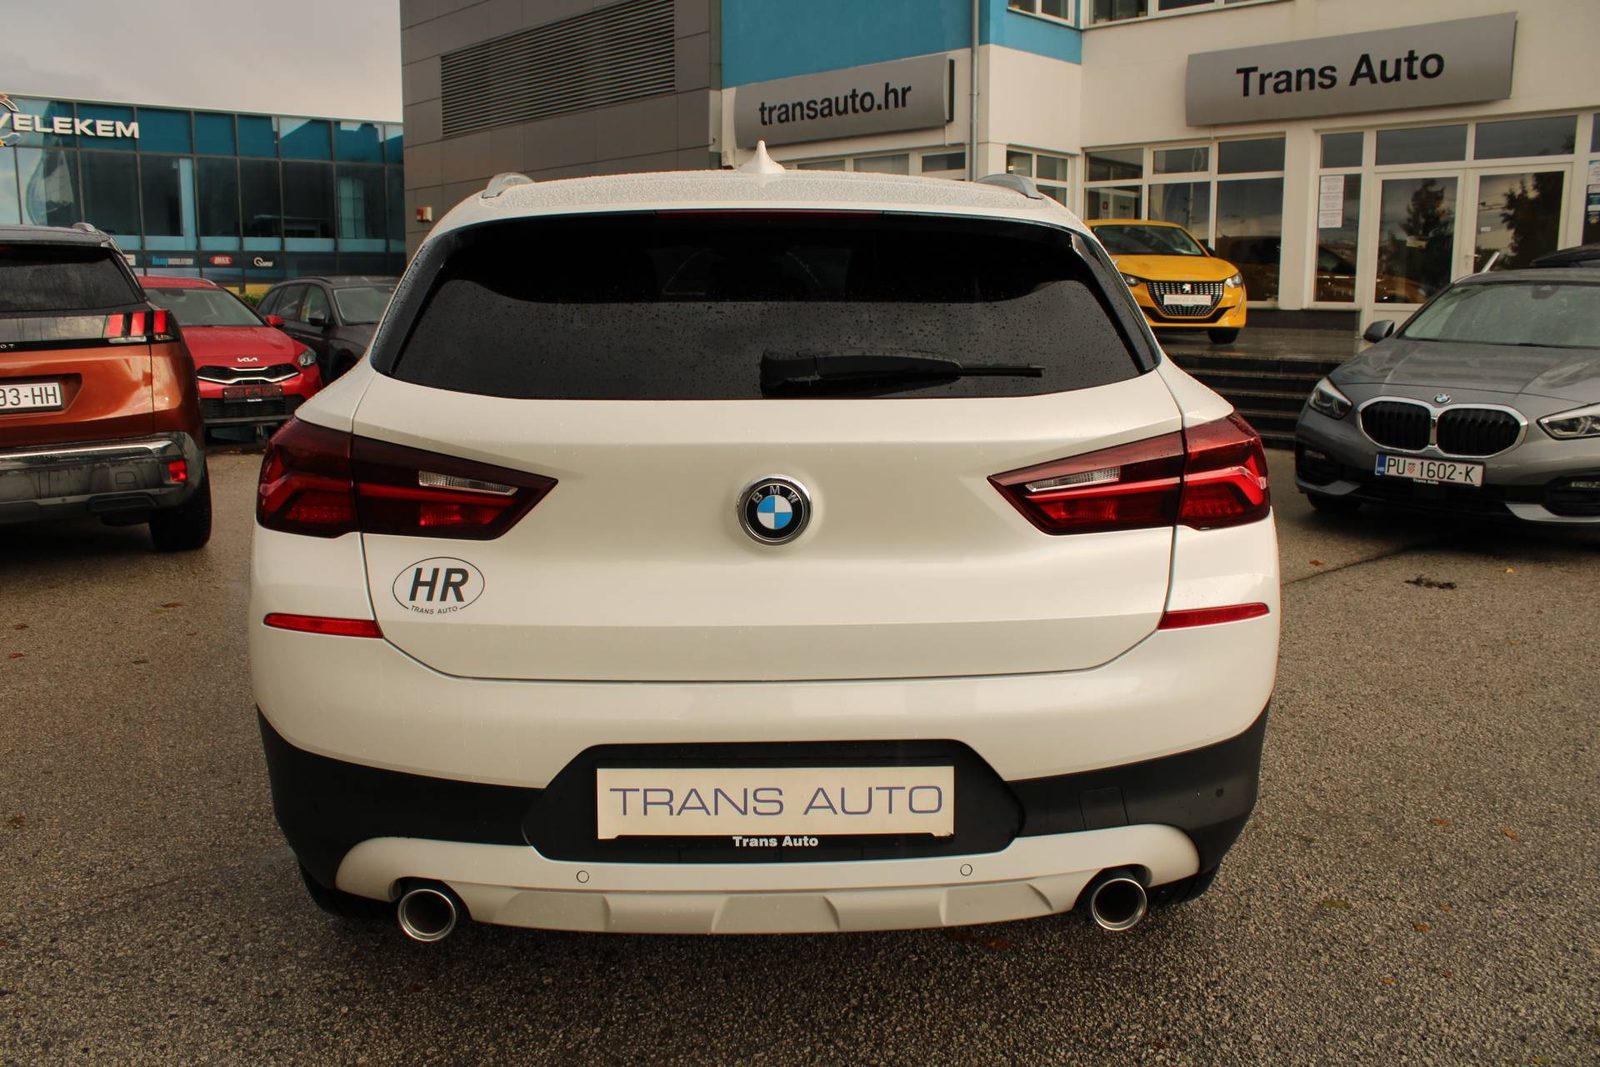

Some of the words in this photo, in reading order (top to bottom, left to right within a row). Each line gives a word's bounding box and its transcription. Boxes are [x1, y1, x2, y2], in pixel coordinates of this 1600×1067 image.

[1236, 64, 1337, 97] Trans
[1348, 49, 1445, 87] Auto
[758, 82, 912, 126] transauto.hr
[1386, 457, 1407, 475] PU
[1419, 461, 1475, 483] 1602-K
[751, 485, 799, 504] BMW
[408, 567, 469, 602] HR
[410, 605, 434, 615] TRANS
[437, 605, 458, 615] AUTO
[609, 787, 784, 816] TRANS
[803, 785, 943, 816] AUTO
[732, 836, 778, 847] Trans
[782, 836, 819, 847] Auto
